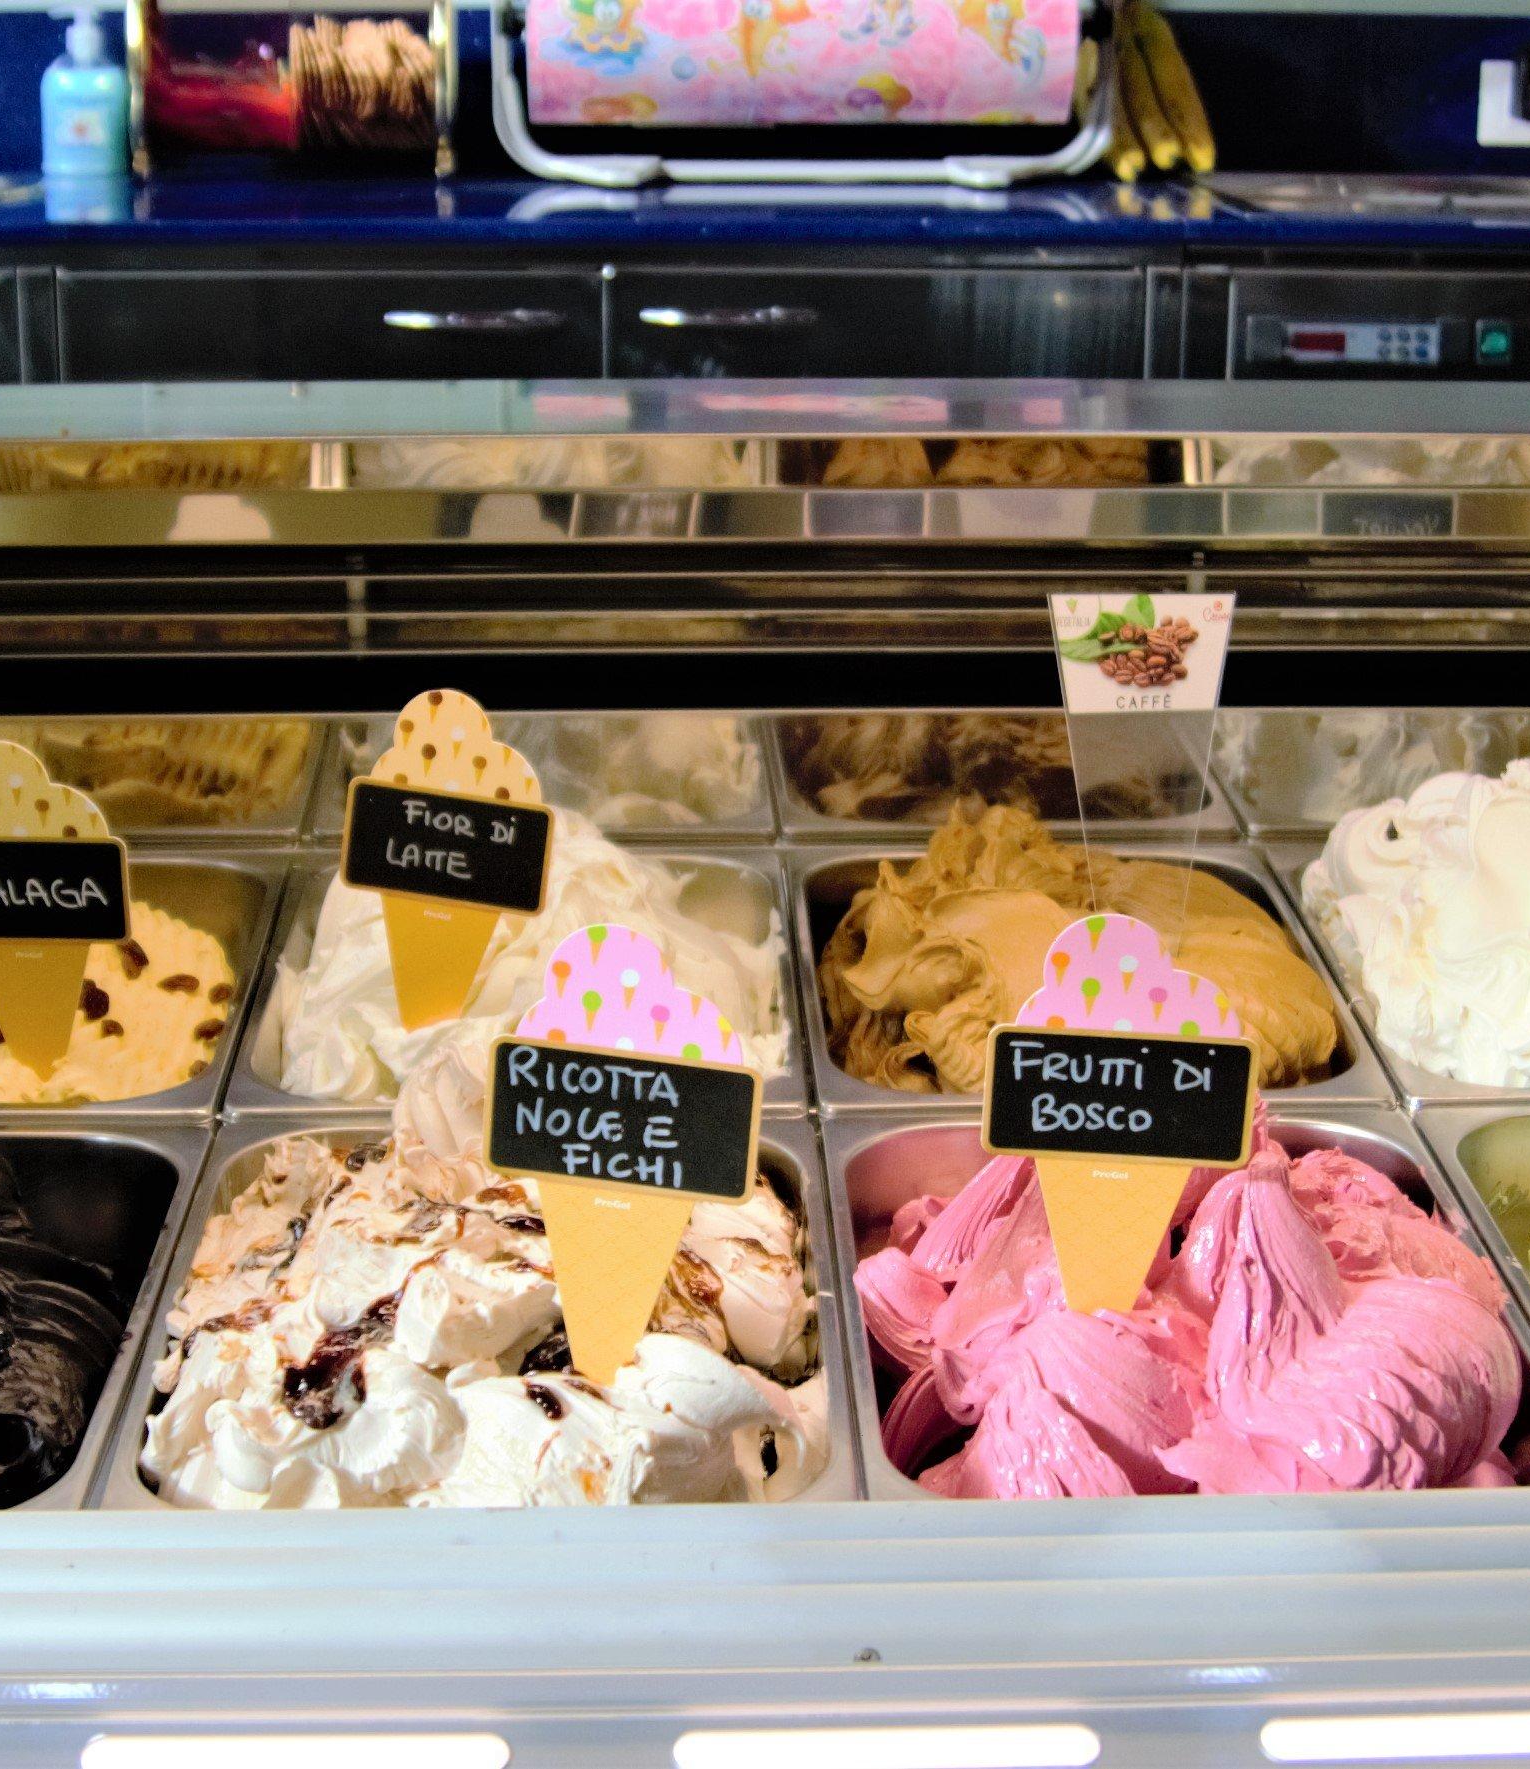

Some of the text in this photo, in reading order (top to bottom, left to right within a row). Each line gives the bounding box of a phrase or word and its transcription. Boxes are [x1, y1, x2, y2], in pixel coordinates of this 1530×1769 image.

[402, 800, 475, 838] FIOR
[385, 838, 472, 879] LATTE
[508, 1046, 680, 1108] RICOTTA
[643, 1115, 679, 1149] E
[1032, 1092, 1153, 1133] BOSCO
[561, 1143, 683, 1189] FICHI
